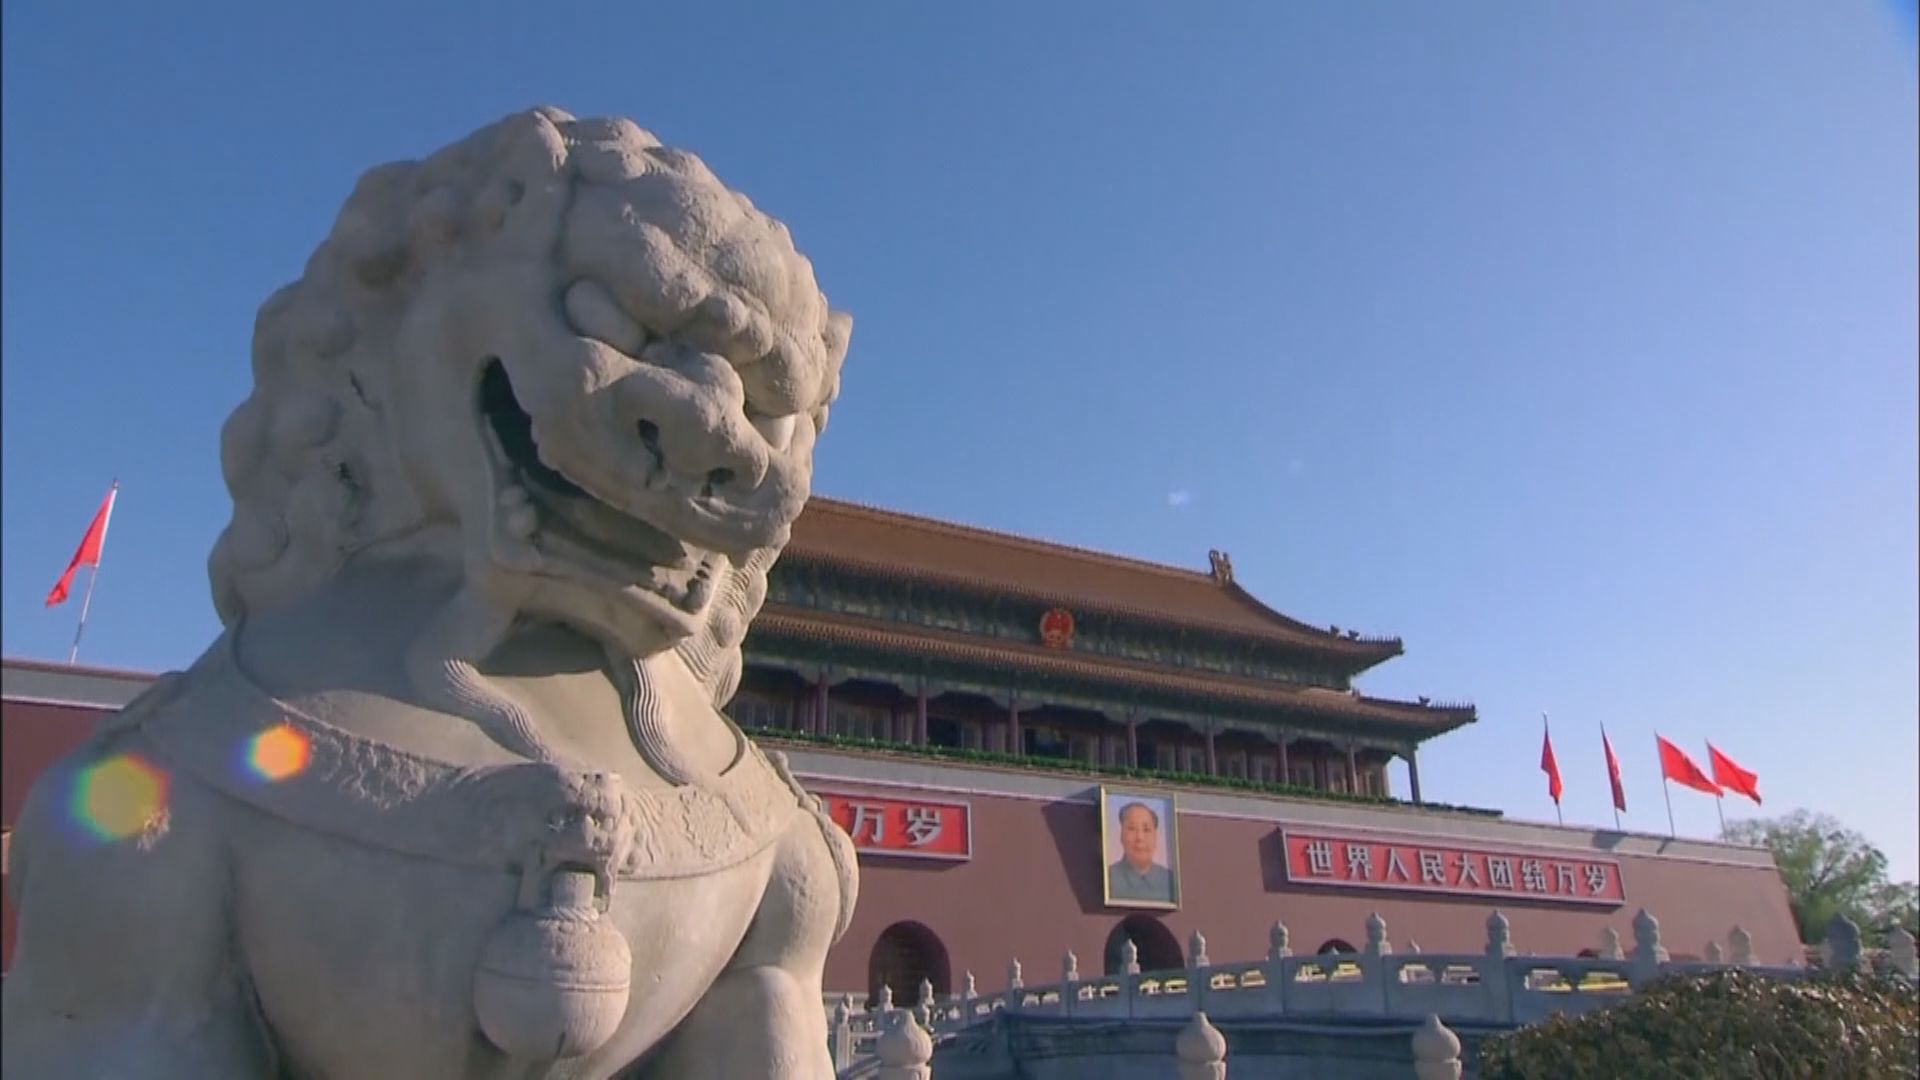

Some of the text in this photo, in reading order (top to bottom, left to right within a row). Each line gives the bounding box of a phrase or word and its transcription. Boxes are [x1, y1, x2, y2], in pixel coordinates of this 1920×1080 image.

[821, 800, 942, 846] 万岁
[1306, 840, 1606, 896] 世界人民大团结万岁
